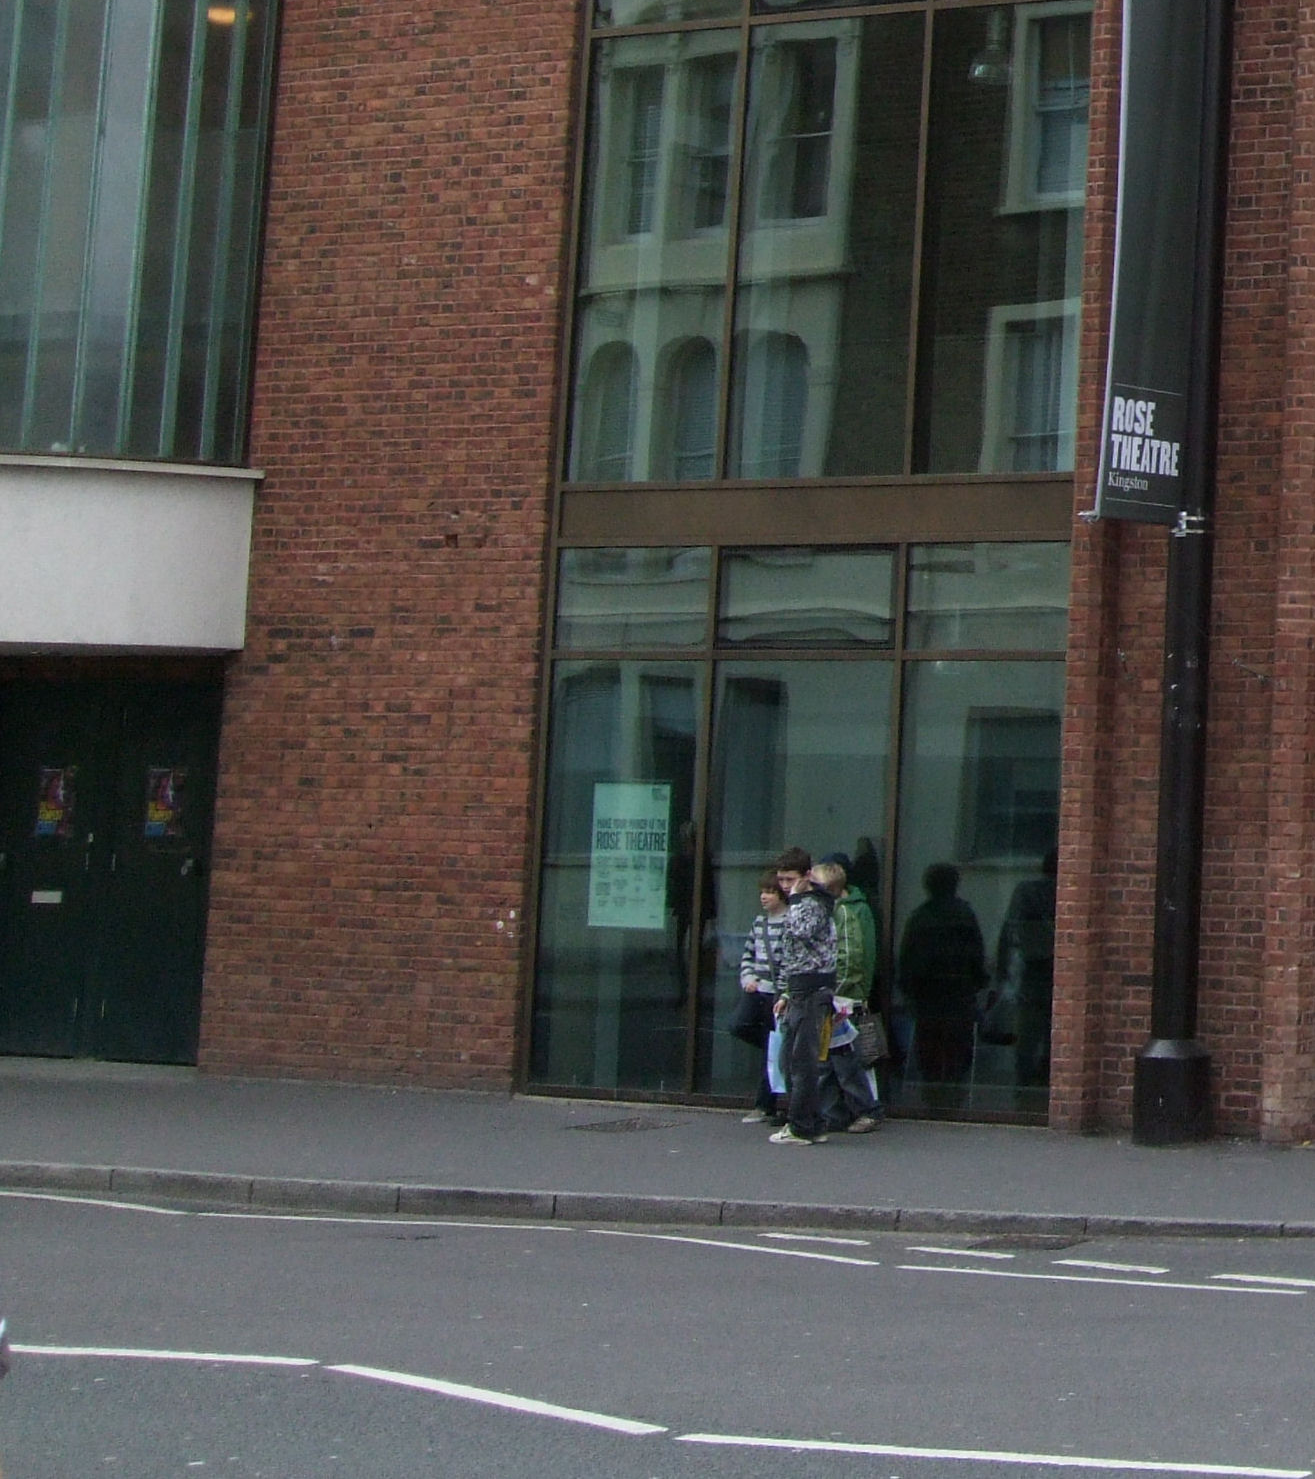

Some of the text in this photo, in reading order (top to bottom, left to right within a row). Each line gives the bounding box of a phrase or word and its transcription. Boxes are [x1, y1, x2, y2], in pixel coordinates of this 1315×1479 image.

[1112, 396, 1156, 436] ROSE
[1112, 433, 1180, 477] THEATRE
[1108, 471, 1149, 492] Kingston
[596, 831, 667, 852] ROSE THEATRE
